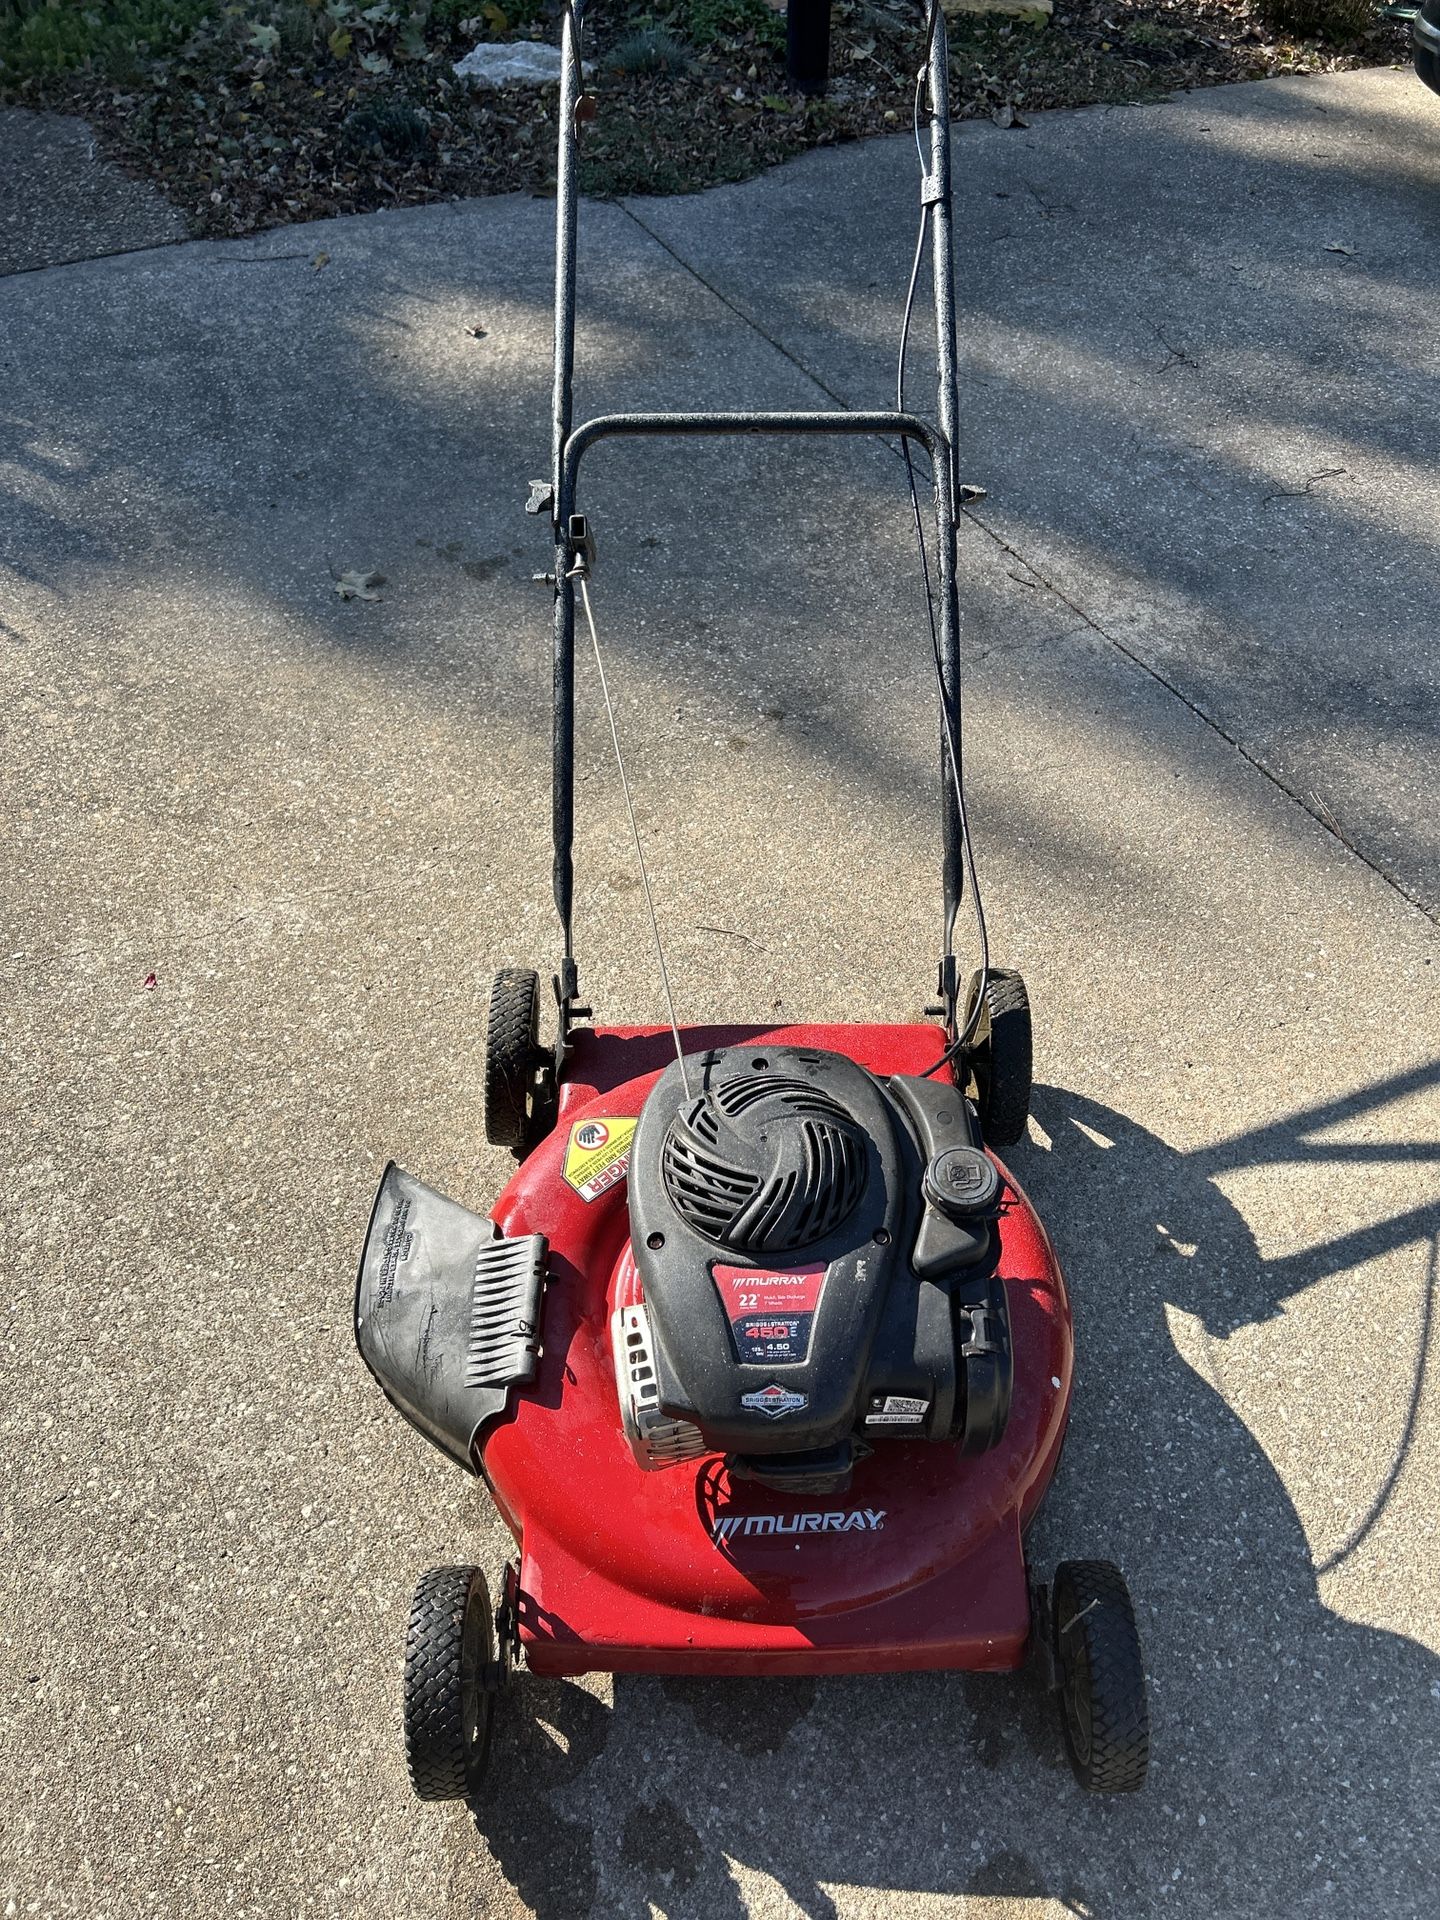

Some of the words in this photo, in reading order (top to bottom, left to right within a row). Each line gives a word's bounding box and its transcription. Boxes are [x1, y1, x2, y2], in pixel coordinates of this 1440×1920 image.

[605, 1153, 617, 1163] AND
[588, 1153, 631, 1193] NGER
[593, 1162, 606, 1174] FEET
[577, 1171, 593, 1185] AWAY
[745, 1276, 807, 1286] MURRAY
[744, 1509, 887, 1535] MURRAY
